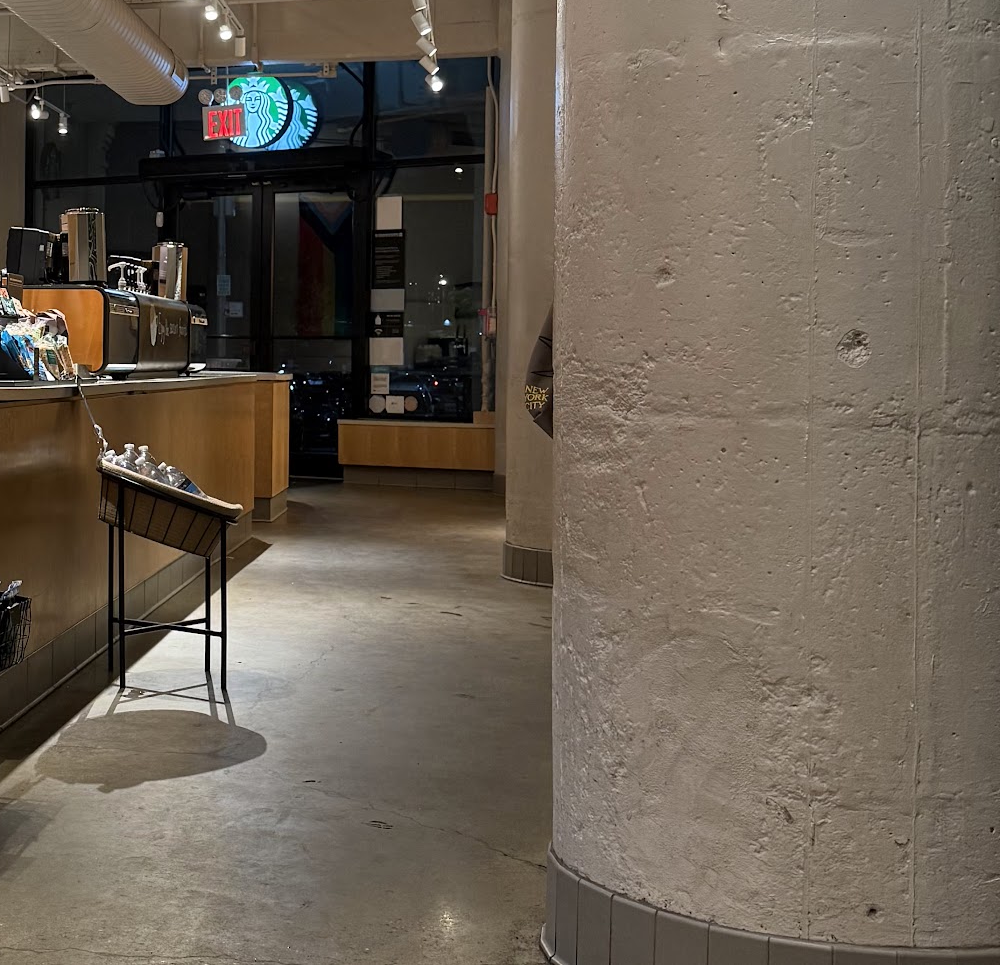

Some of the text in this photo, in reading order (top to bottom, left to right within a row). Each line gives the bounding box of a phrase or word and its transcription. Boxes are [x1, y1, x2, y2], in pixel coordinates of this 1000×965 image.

[208, 108, 242, 138] EXIT
[525, 385, 549, 394] NEW
[525, 402, 545, 410] CITY
